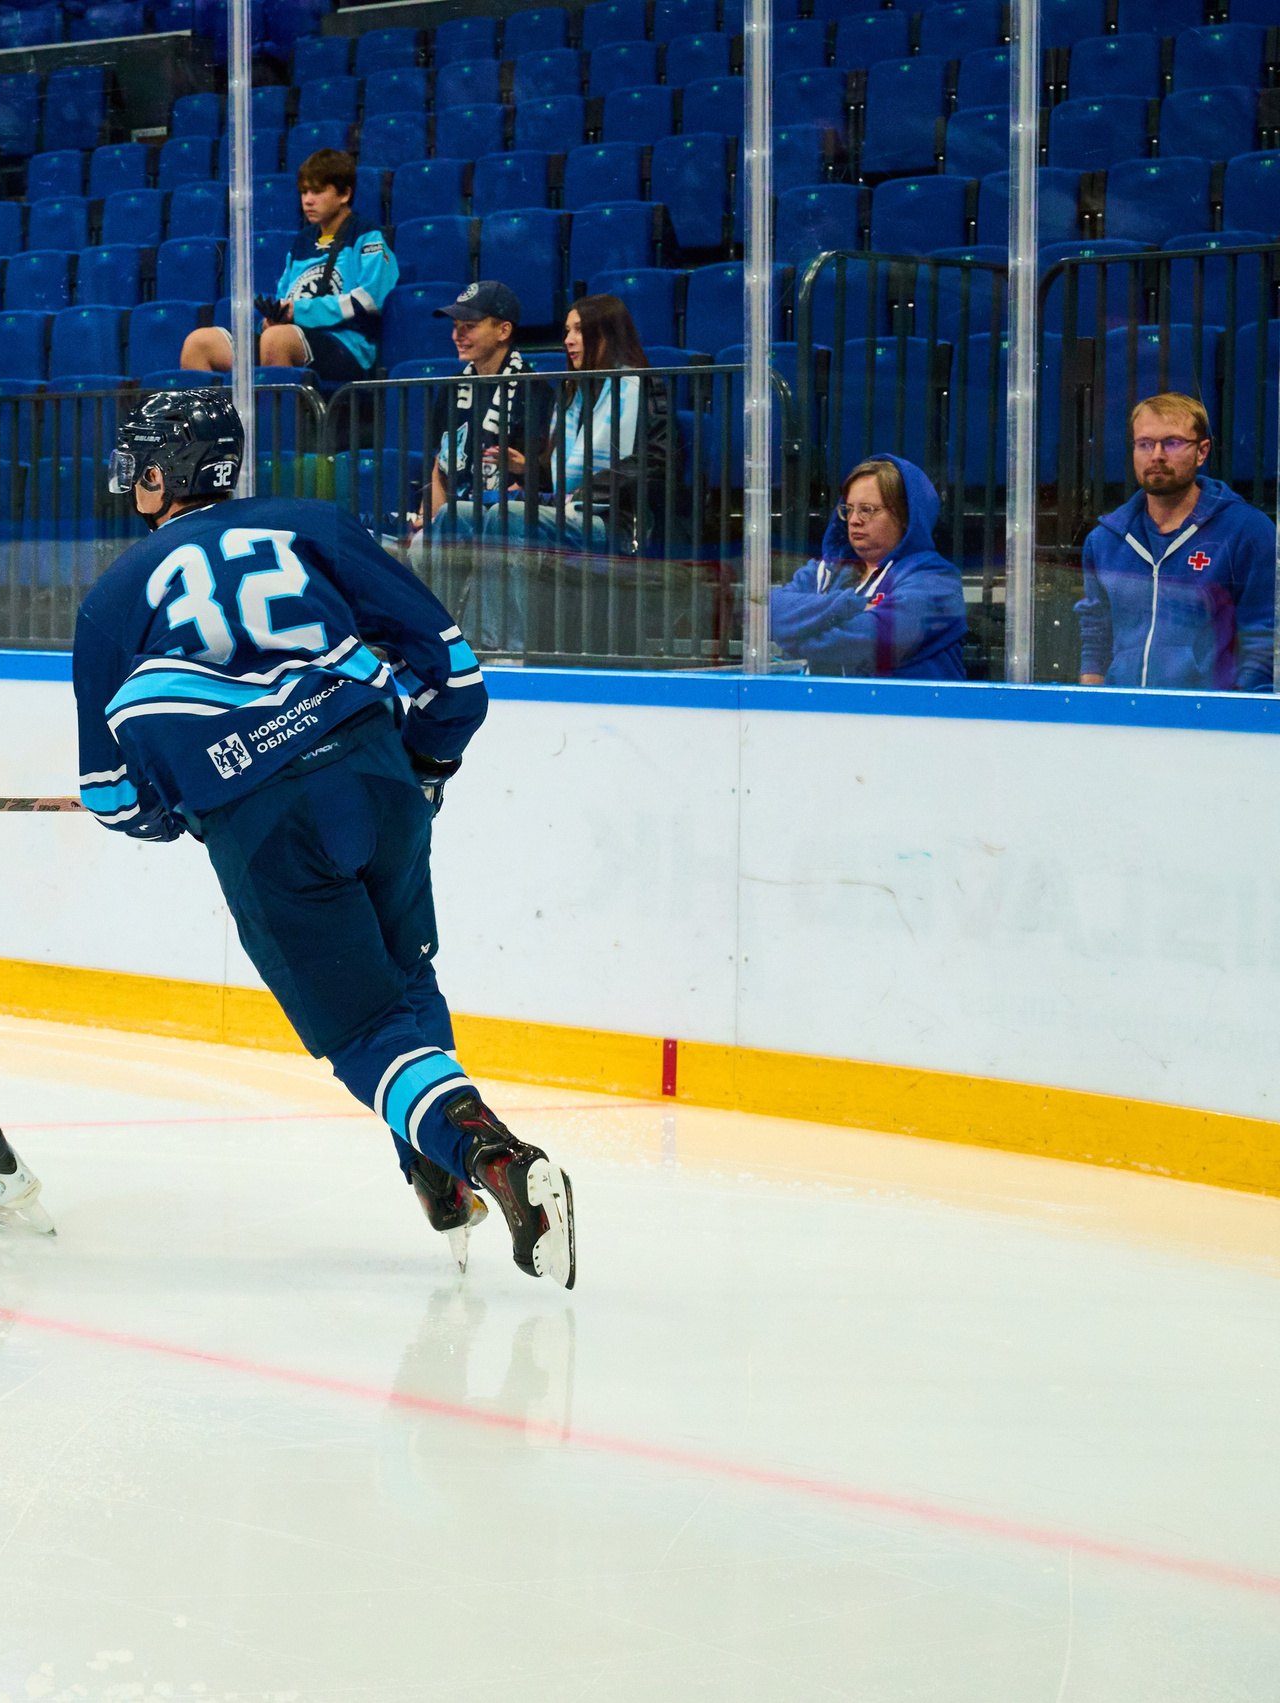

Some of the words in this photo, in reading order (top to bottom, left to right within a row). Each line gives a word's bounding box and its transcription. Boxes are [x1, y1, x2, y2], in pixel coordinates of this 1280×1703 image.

[212, 464, 232, 487] 32
[146, 528, 329, 665] 32
[248, 679, 353, 742] НОВОСИБИРСКА
[256, 714, 319, 753] ОБЛАСТЬ
